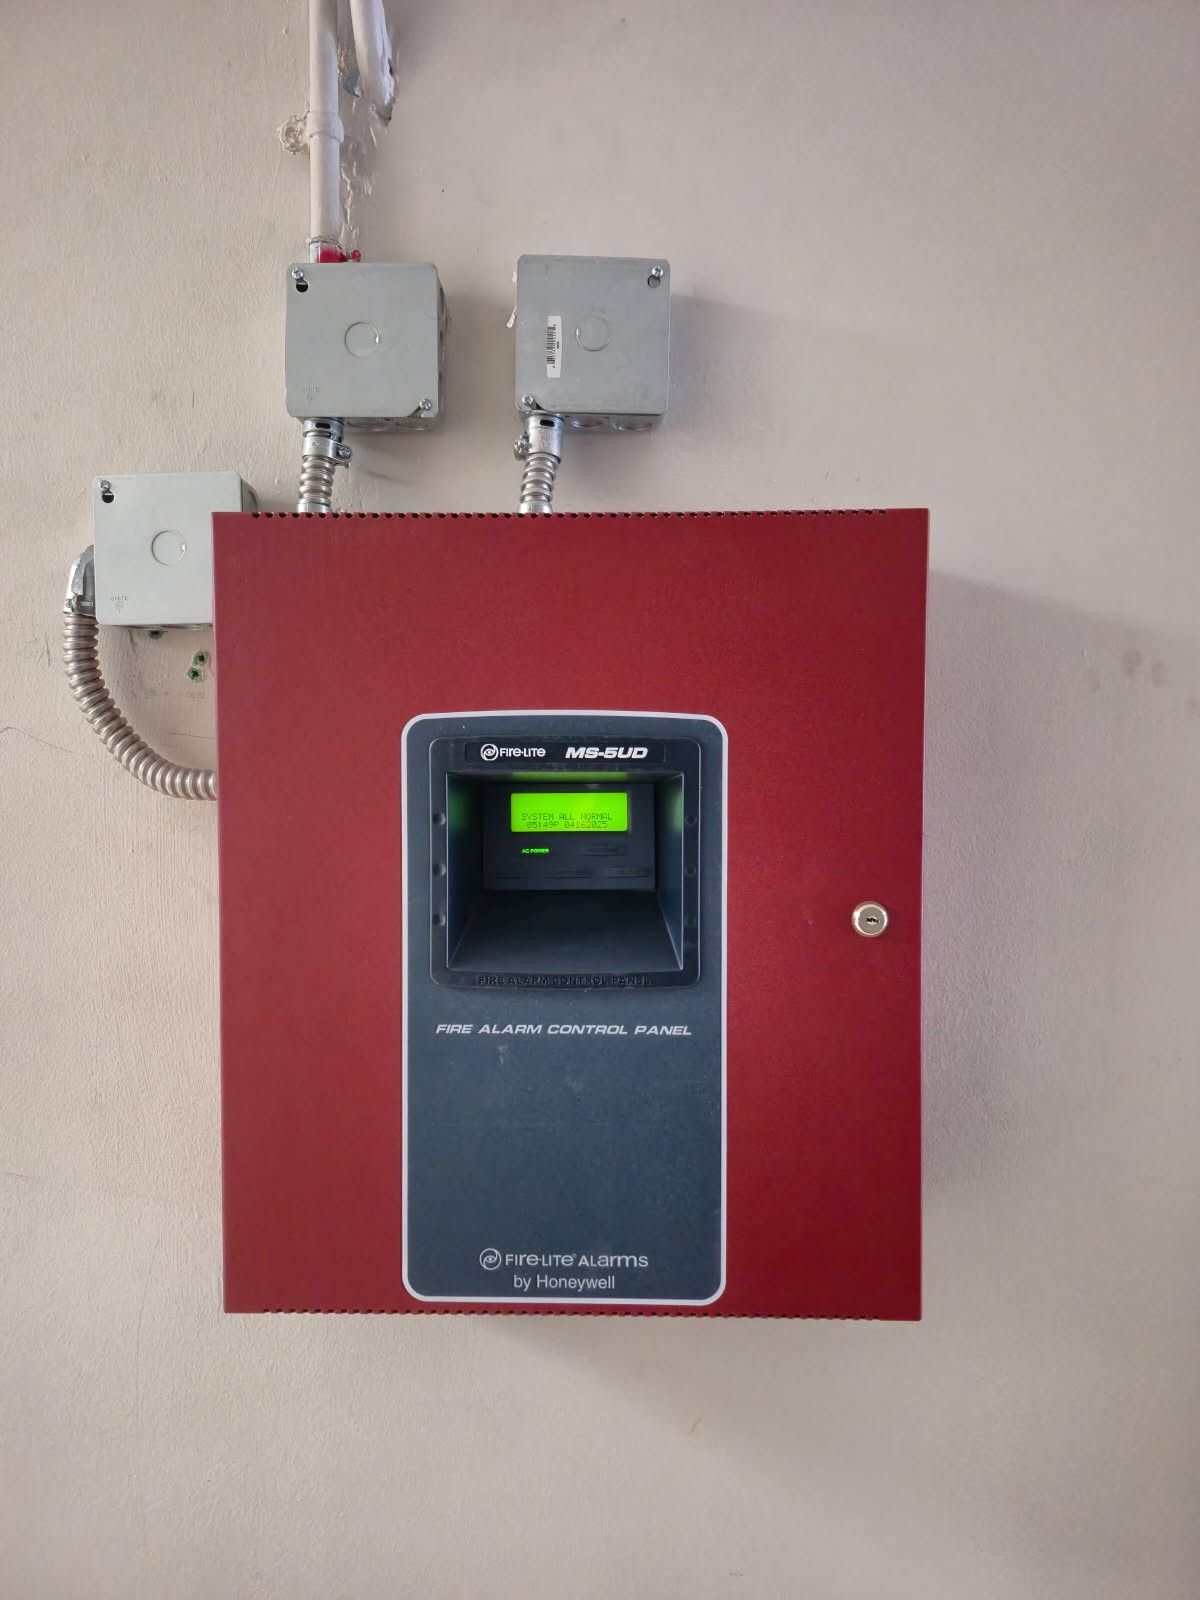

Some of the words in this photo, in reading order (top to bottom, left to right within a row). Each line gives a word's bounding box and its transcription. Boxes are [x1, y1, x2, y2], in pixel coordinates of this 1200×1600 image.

[565, 746, 649, 759] MS-5UD
[521, 812, 554, 821] SYSTEM
[558, 812, 575, 821] ALL
[580, 812, 613, 821] NORMAL
[526, 820, 560, 829] 05:49P
[479, 975, 504, 985] FIRE
[508, 975, 550, 985] ALARM
[552, 975, 608, 986] CONTROL
[435, 1023, 473, 1034] FIRE
[478, 1023, 542, 1035] ALARM
[547, 1024, 628, 1035] CONTROL
[634, 1025, 692, 1036] PANEL
[513, 1274, 532, 1292] by
[536, 1274, 615, 1292] Honeywell
